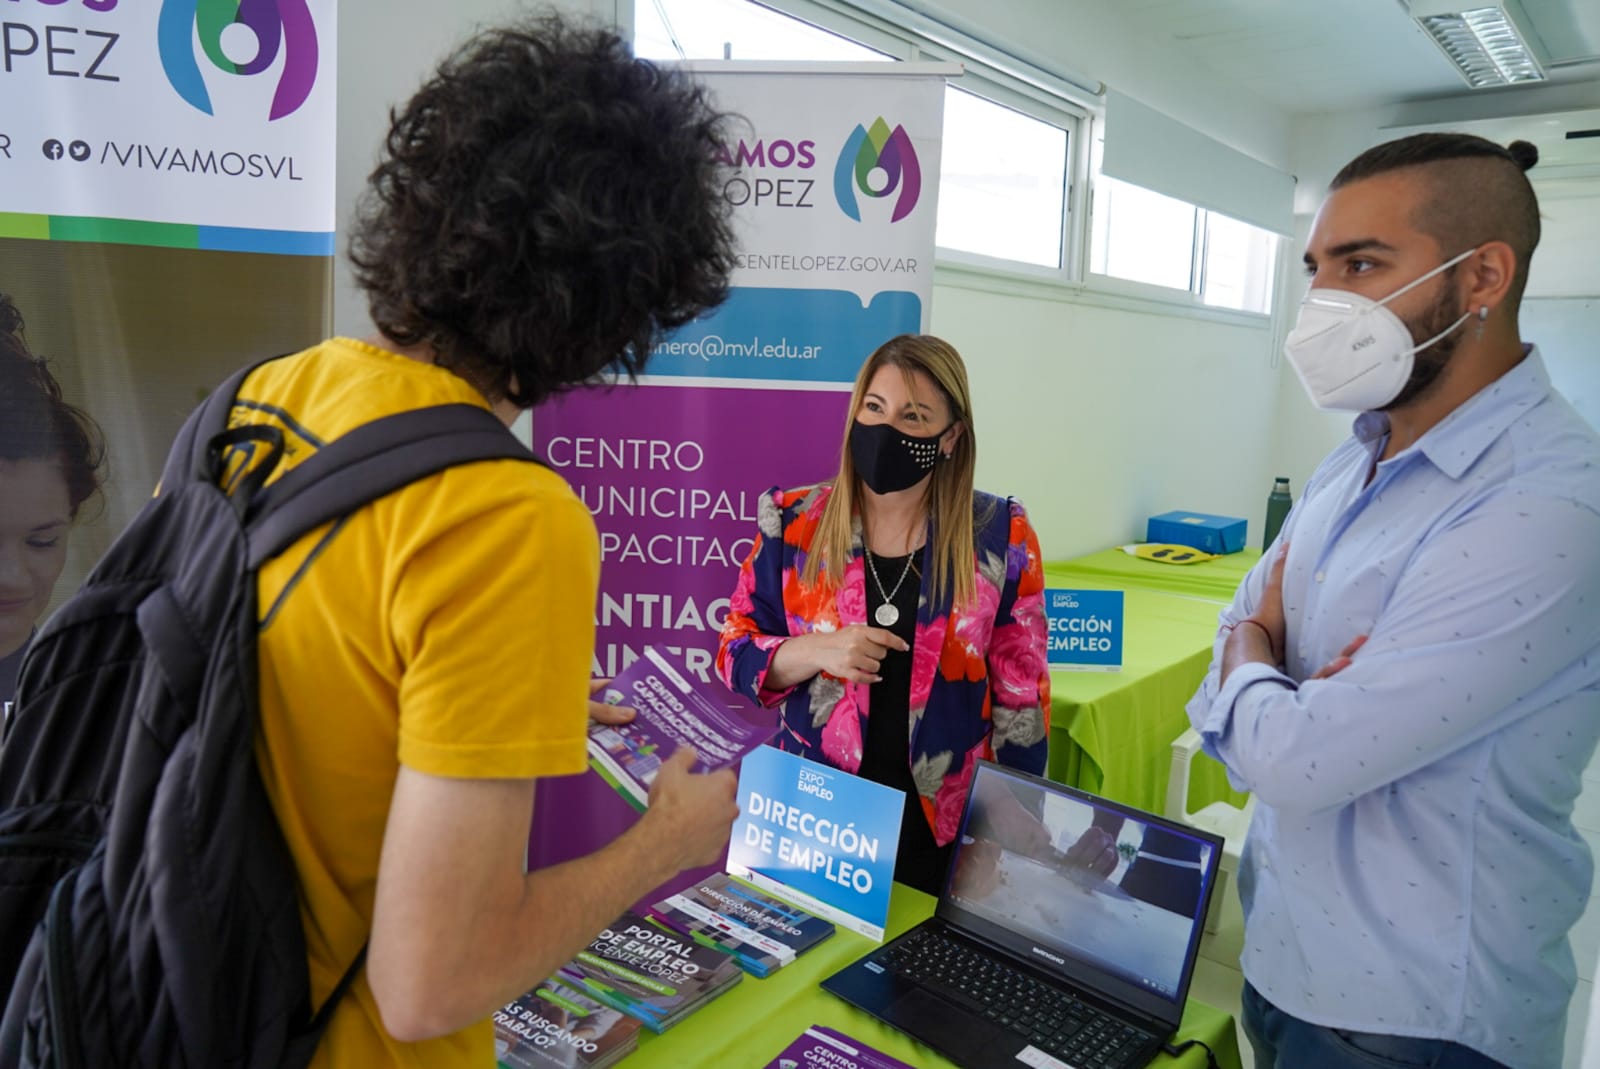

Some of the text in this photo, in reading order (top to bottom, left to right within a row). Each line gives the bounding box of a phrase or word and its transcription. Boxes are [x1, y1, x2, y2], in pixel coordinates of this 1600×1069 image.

[2, 22, 121, 82] PEZ
[547, 436, 704, 472] CENTRO
[568, 484, 757, 522] UNICIPAL
[593, 592, 731, 632] NTIAG
[1048, 614, 1112, 633] ECCIÓN
[1047, 636, 1112, 652] EMPLEO
[798, 780, 834, 801] EMPLEO
[800, 769, 825, 787] EXPO
[748, 791, 879, 863] DIRECCIÓN
[745, 823, 873, 894] DE EMPLEO
[624, 925, 693, 959] PORTAL
[763, 914, 803, 937] EMPLEO
[598, 929, 626, 946] DE
[623, 940, 700, 974] EMPLEO
[493, 1010, 557, 1049] TRABAJO?
[519, 1010, 598, 1053] BUSCANDO
[814, 1045, 857, 1069] CENTRO
